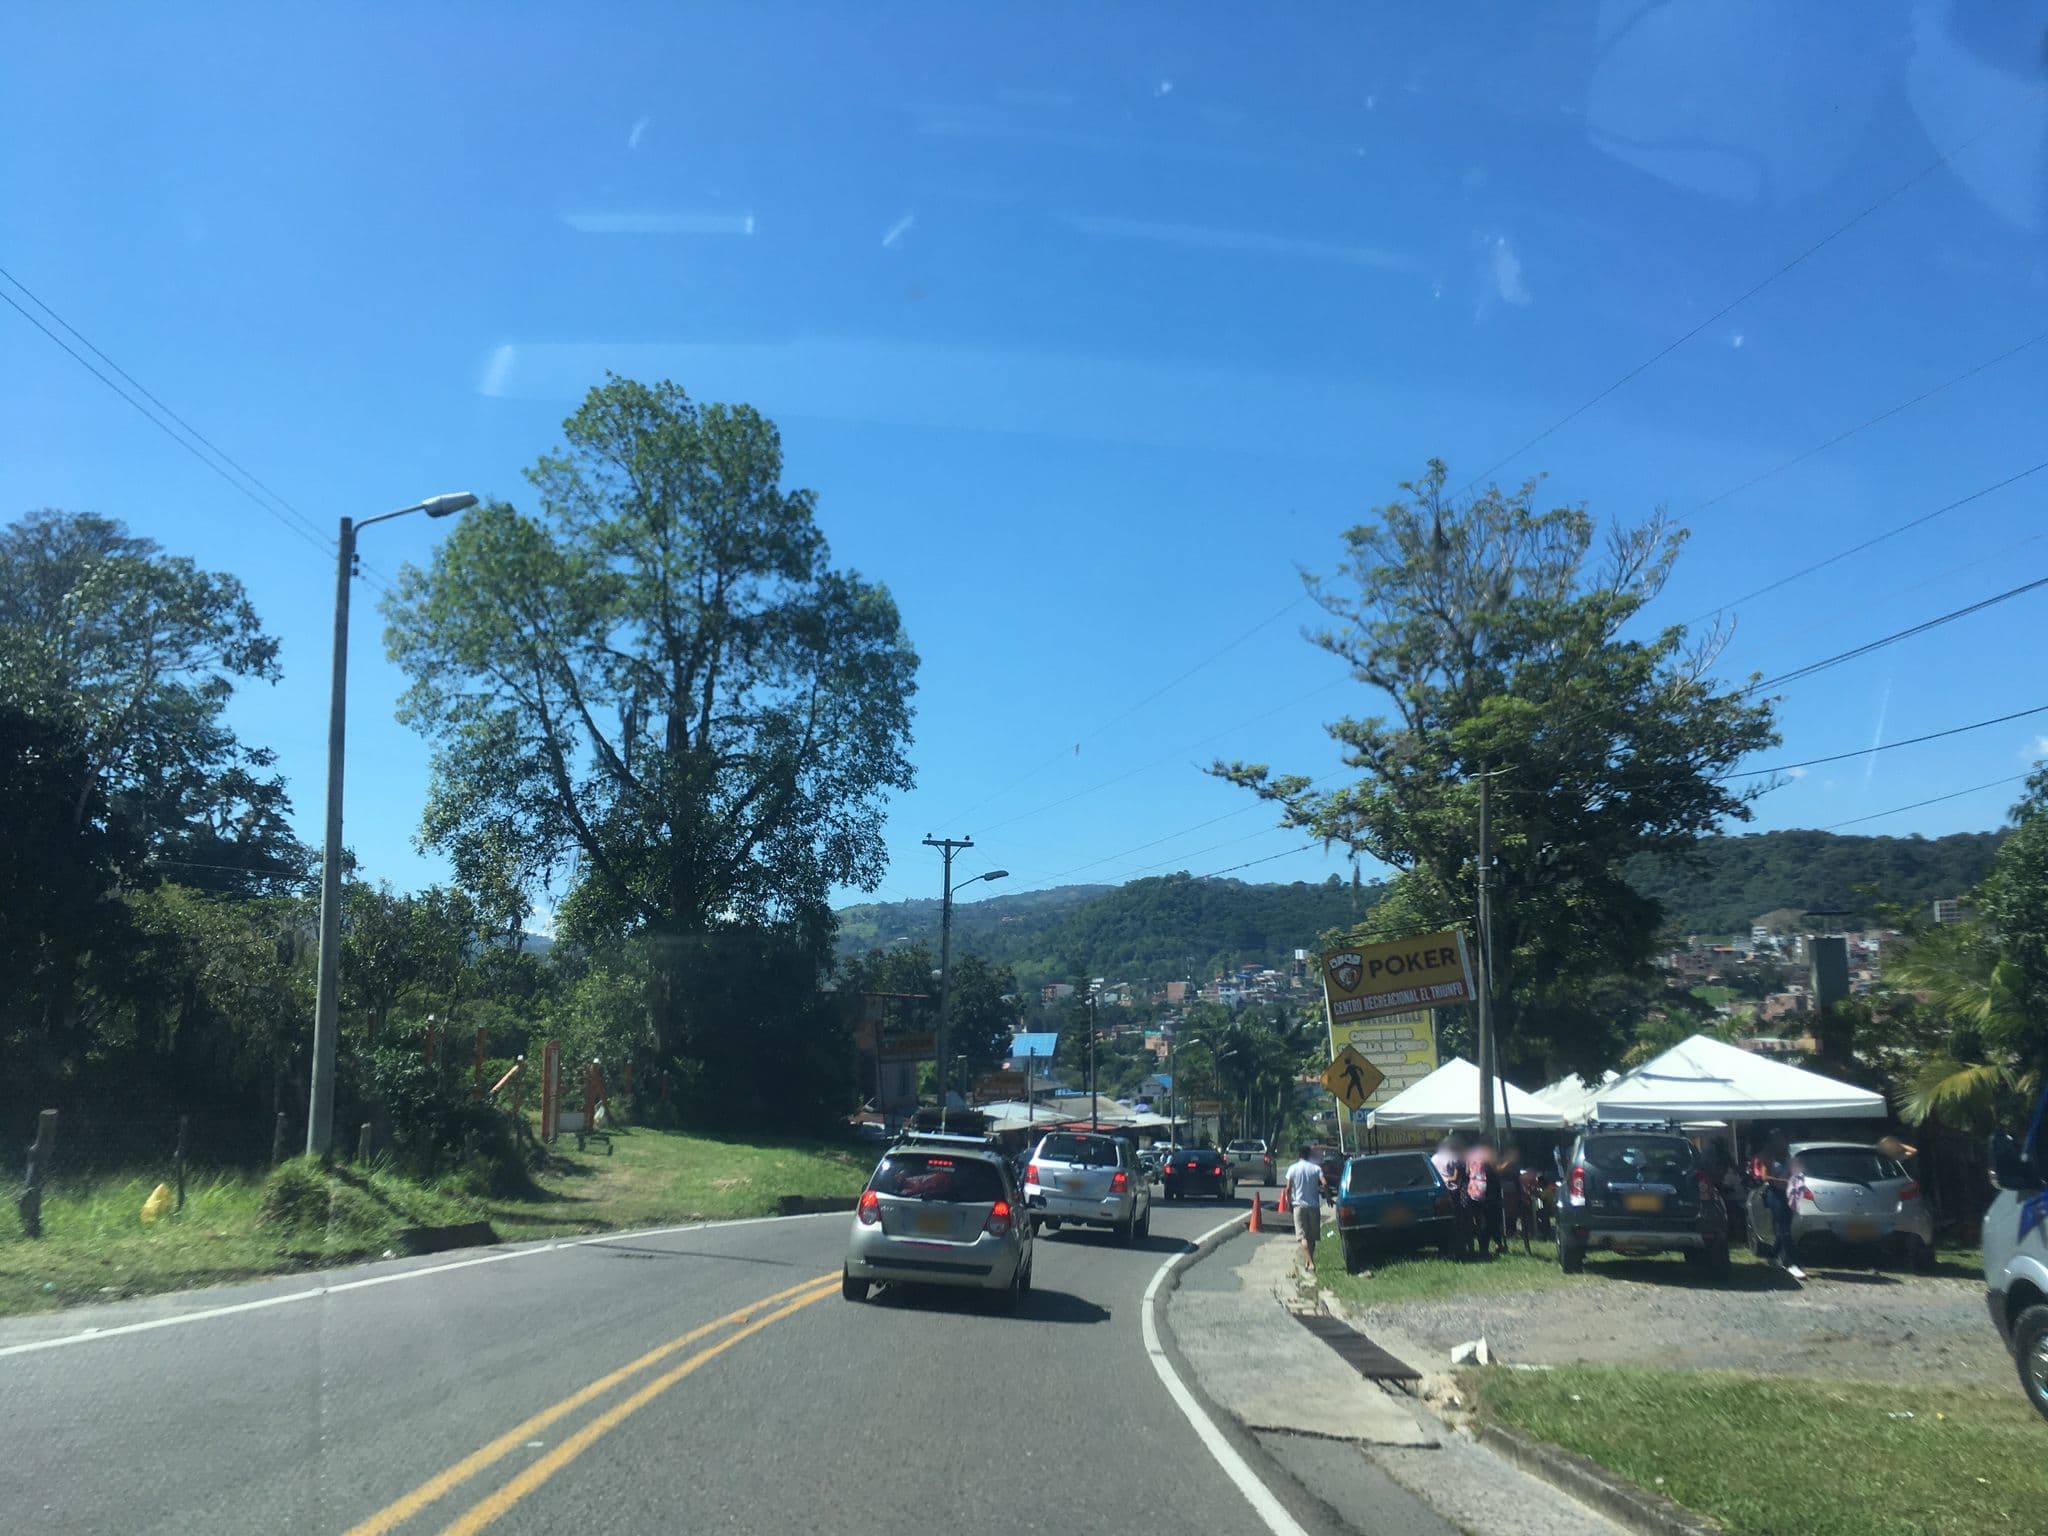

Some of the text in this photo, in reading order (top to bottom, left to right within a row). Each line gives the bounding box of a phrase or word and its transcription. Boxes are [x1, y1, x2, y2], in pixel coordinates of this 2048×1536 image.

[1369, 947, 1457, 978] POKER
[1333, 999, 1363, 1016] CENTRO
[1363, 989, 1420, 1010] RECREACIONAL
[1420, 987, 1432, 1001] EL
